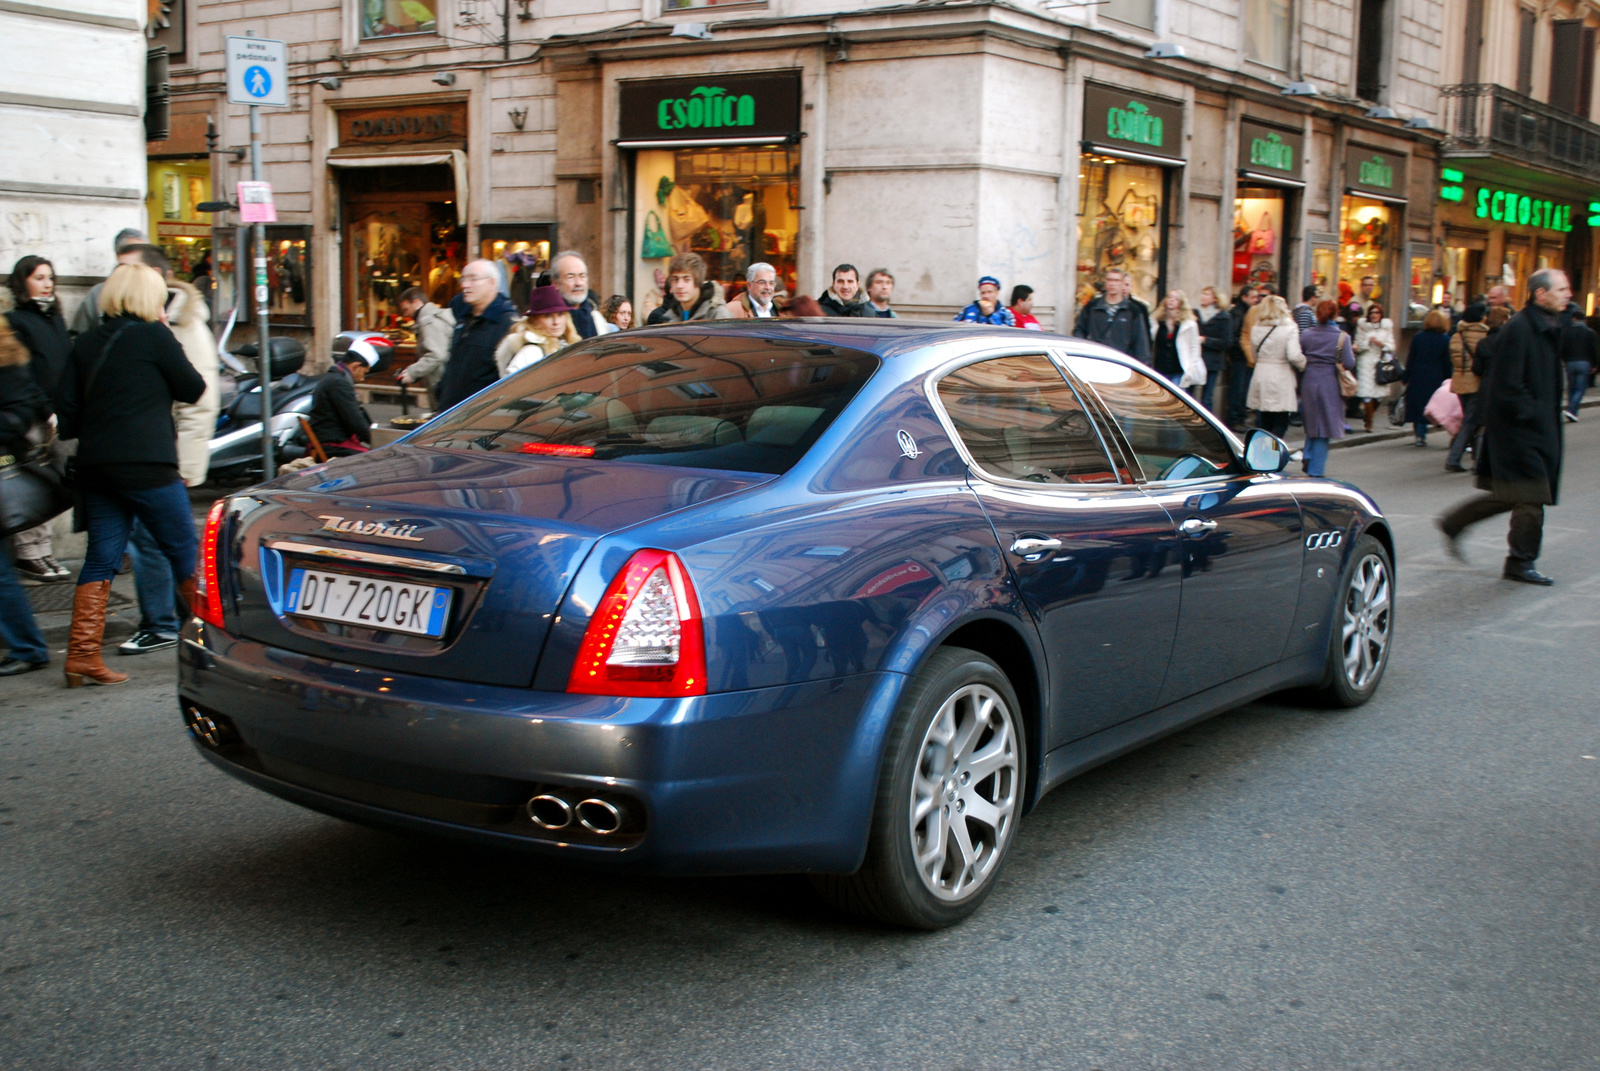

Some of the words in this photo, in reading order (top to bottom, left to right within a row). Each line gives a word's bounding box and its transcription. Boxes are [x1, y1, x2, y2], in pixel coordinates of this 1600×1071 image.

[235, 52, 277, 62] pedonale
[351, 114, 451, 137] COMANDINI
[657, 86, 756, 130] ESOTICA
[1476, 187, 1573, 232] SCHOSTAL
[317, 514, 424, 542] Maserati
[301, 574, 336, 613] DT
[342, 580, 430, 629] 720GK
